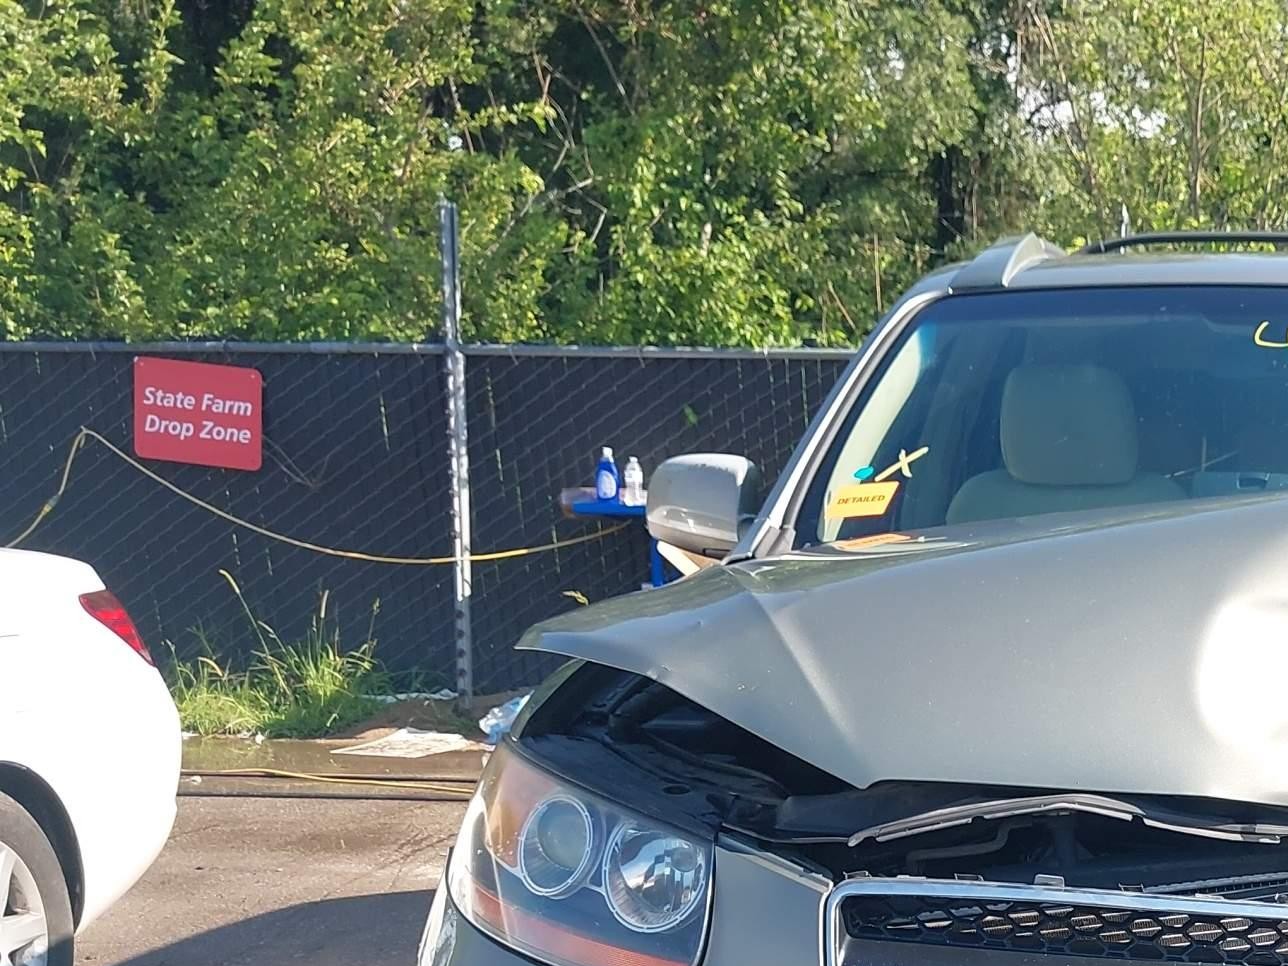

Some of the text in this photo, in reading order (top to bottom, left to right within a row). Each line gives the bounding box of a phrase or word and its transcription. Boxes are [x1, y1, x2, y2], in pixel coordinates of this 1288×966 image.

[143, 387, 253, 416] State Farm
[144, 414, 252, 443] Drop Zone
[837, 494, 886, 505] DETAILED
